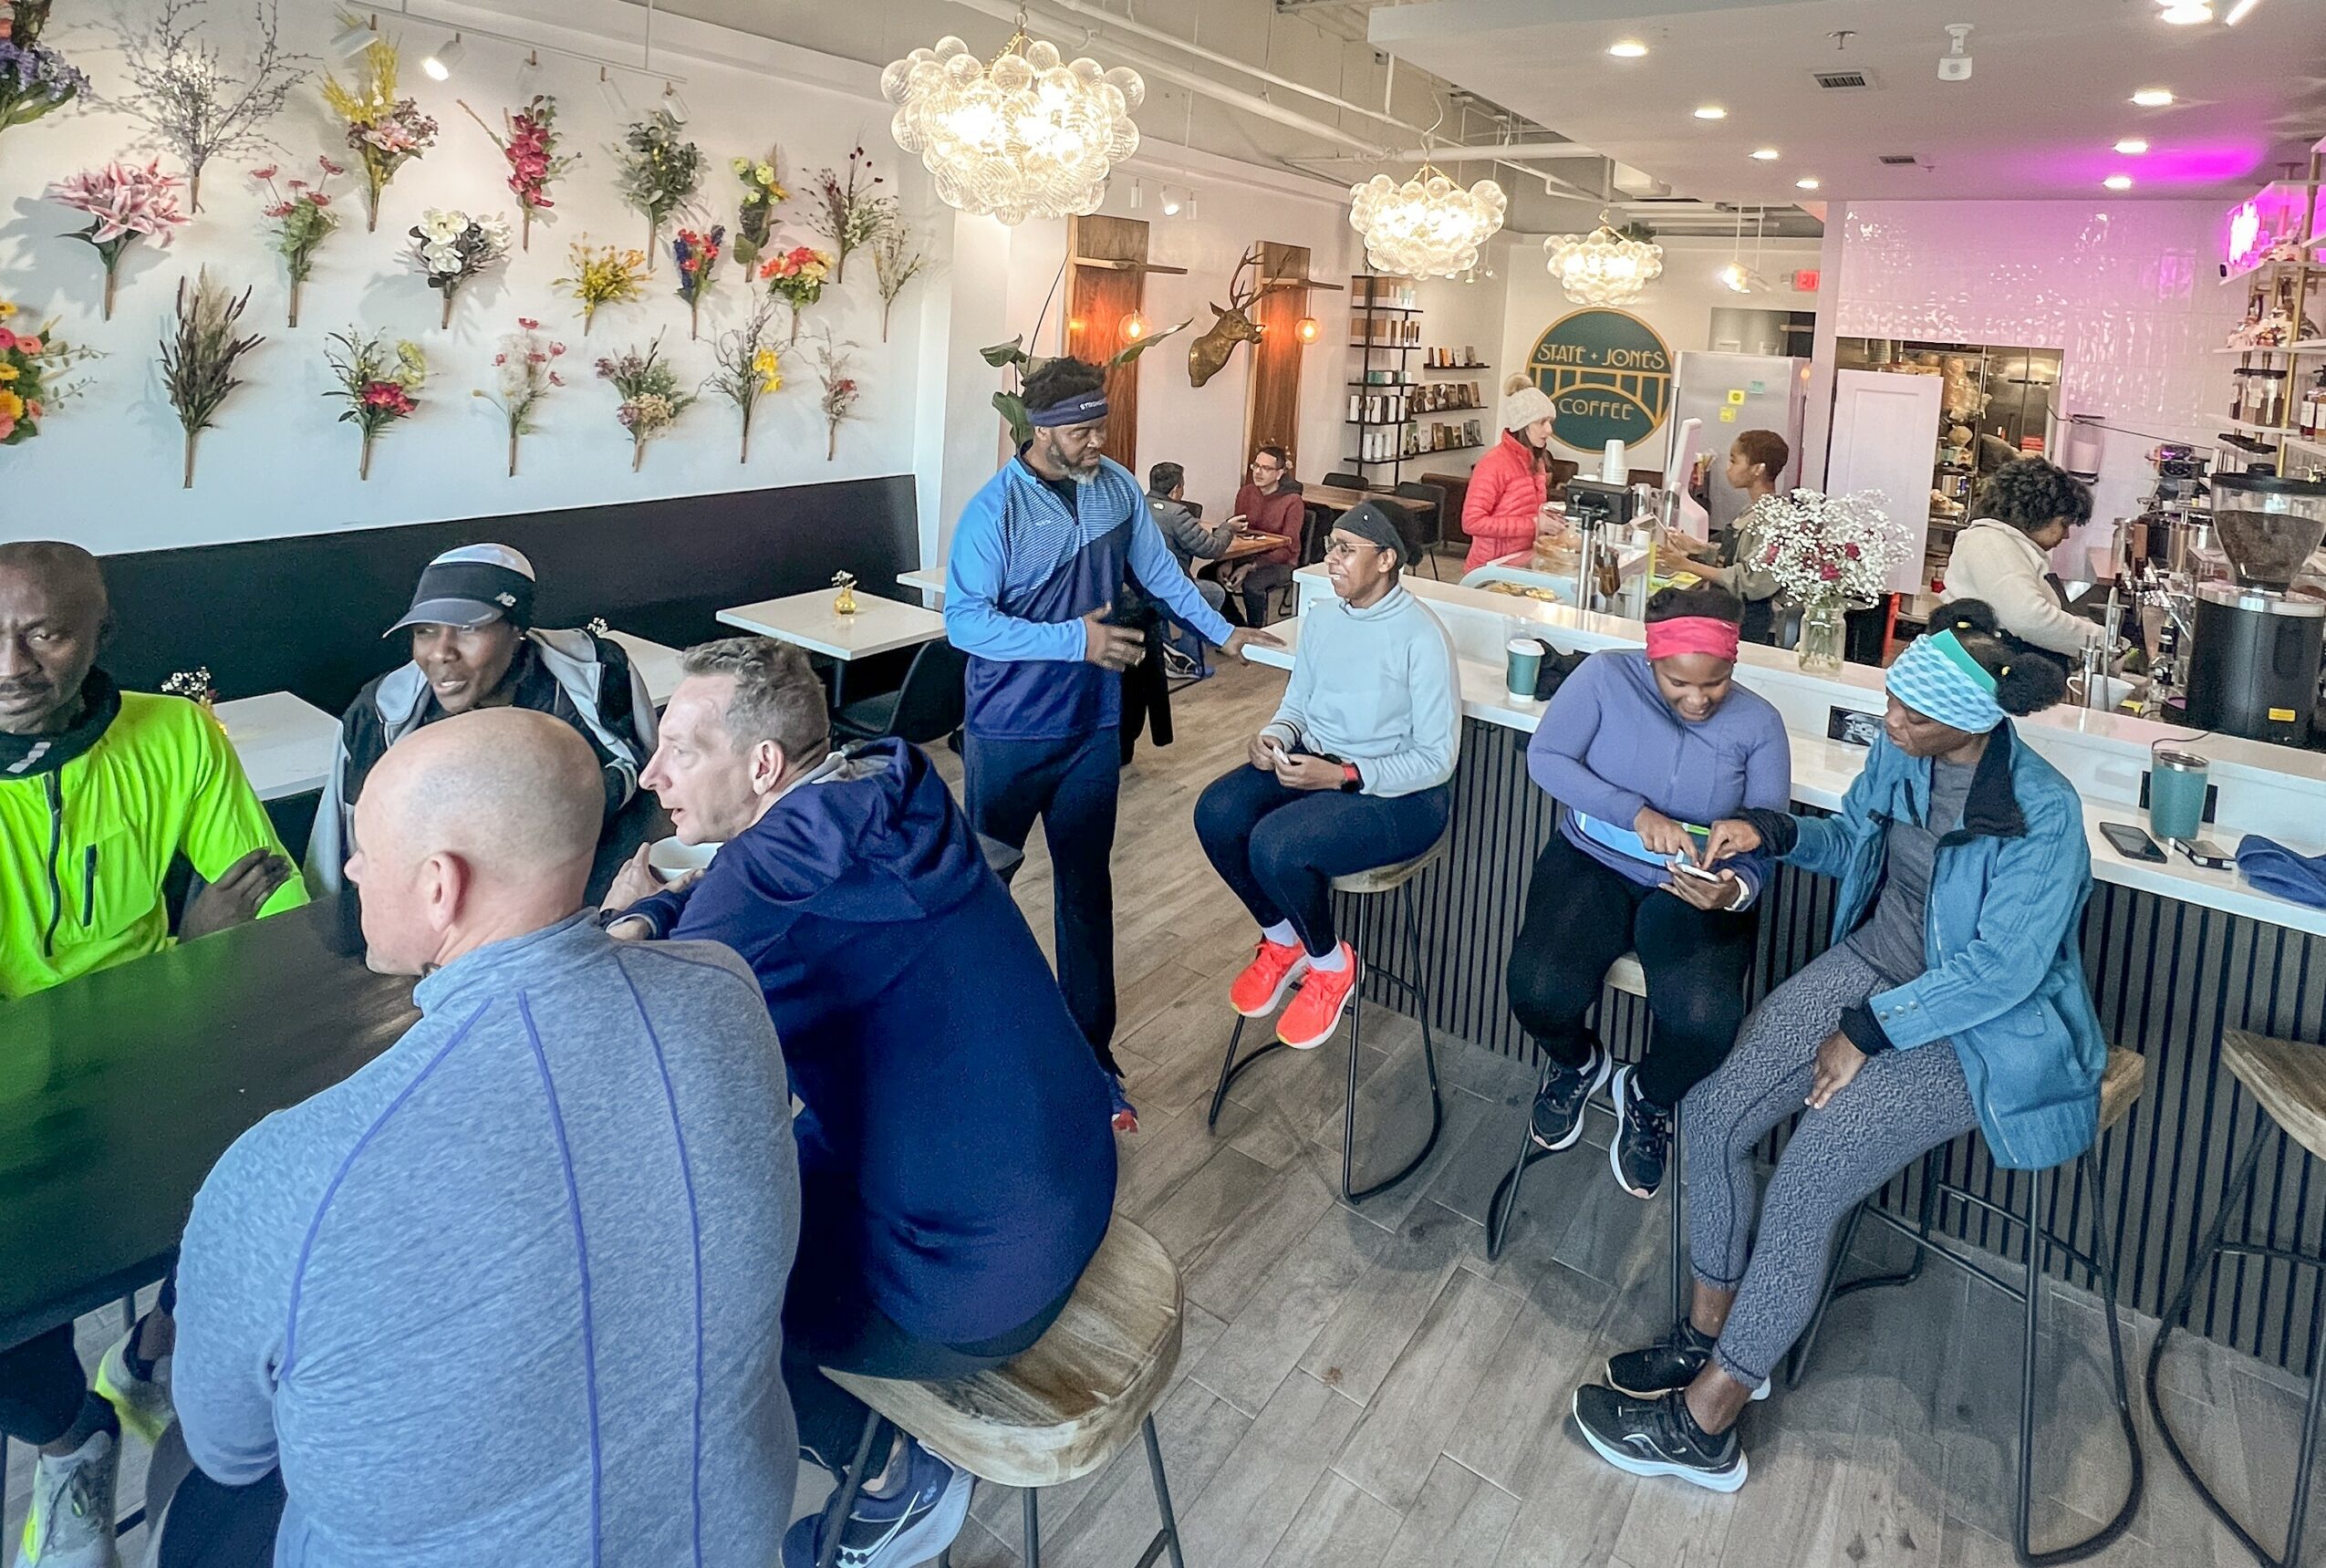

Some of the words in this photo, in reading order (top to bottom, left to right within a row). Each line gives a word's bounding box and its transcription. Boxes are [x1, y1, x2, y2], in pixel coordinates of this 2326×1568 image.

[1537, 344, 1587, 364] STATE
[1602, 348, 1665, 370] JONES
[1558, 398, 1635, 421] COFFEE
